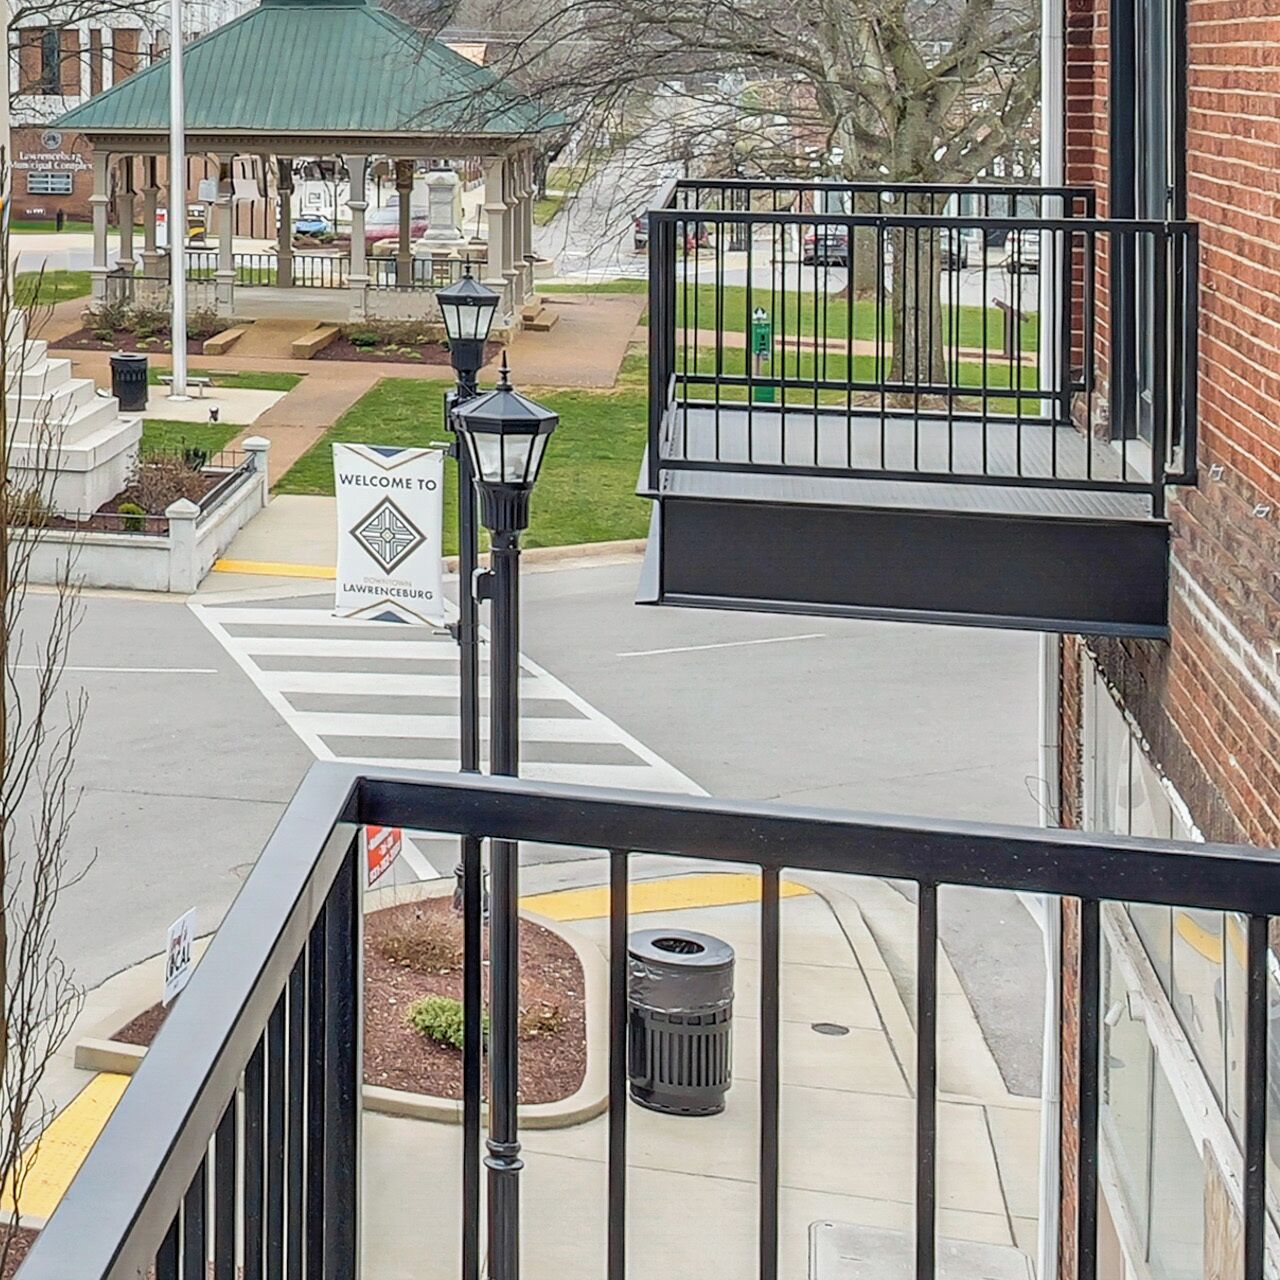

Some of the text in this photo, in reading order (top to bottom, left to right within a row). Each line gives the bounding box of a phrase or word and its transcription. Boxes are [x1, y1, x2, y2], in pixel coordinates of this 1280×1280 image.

[339, 473, 437, 491] WELCOME TO
[343, 583, 433, 600] LAWRENCEBURG
